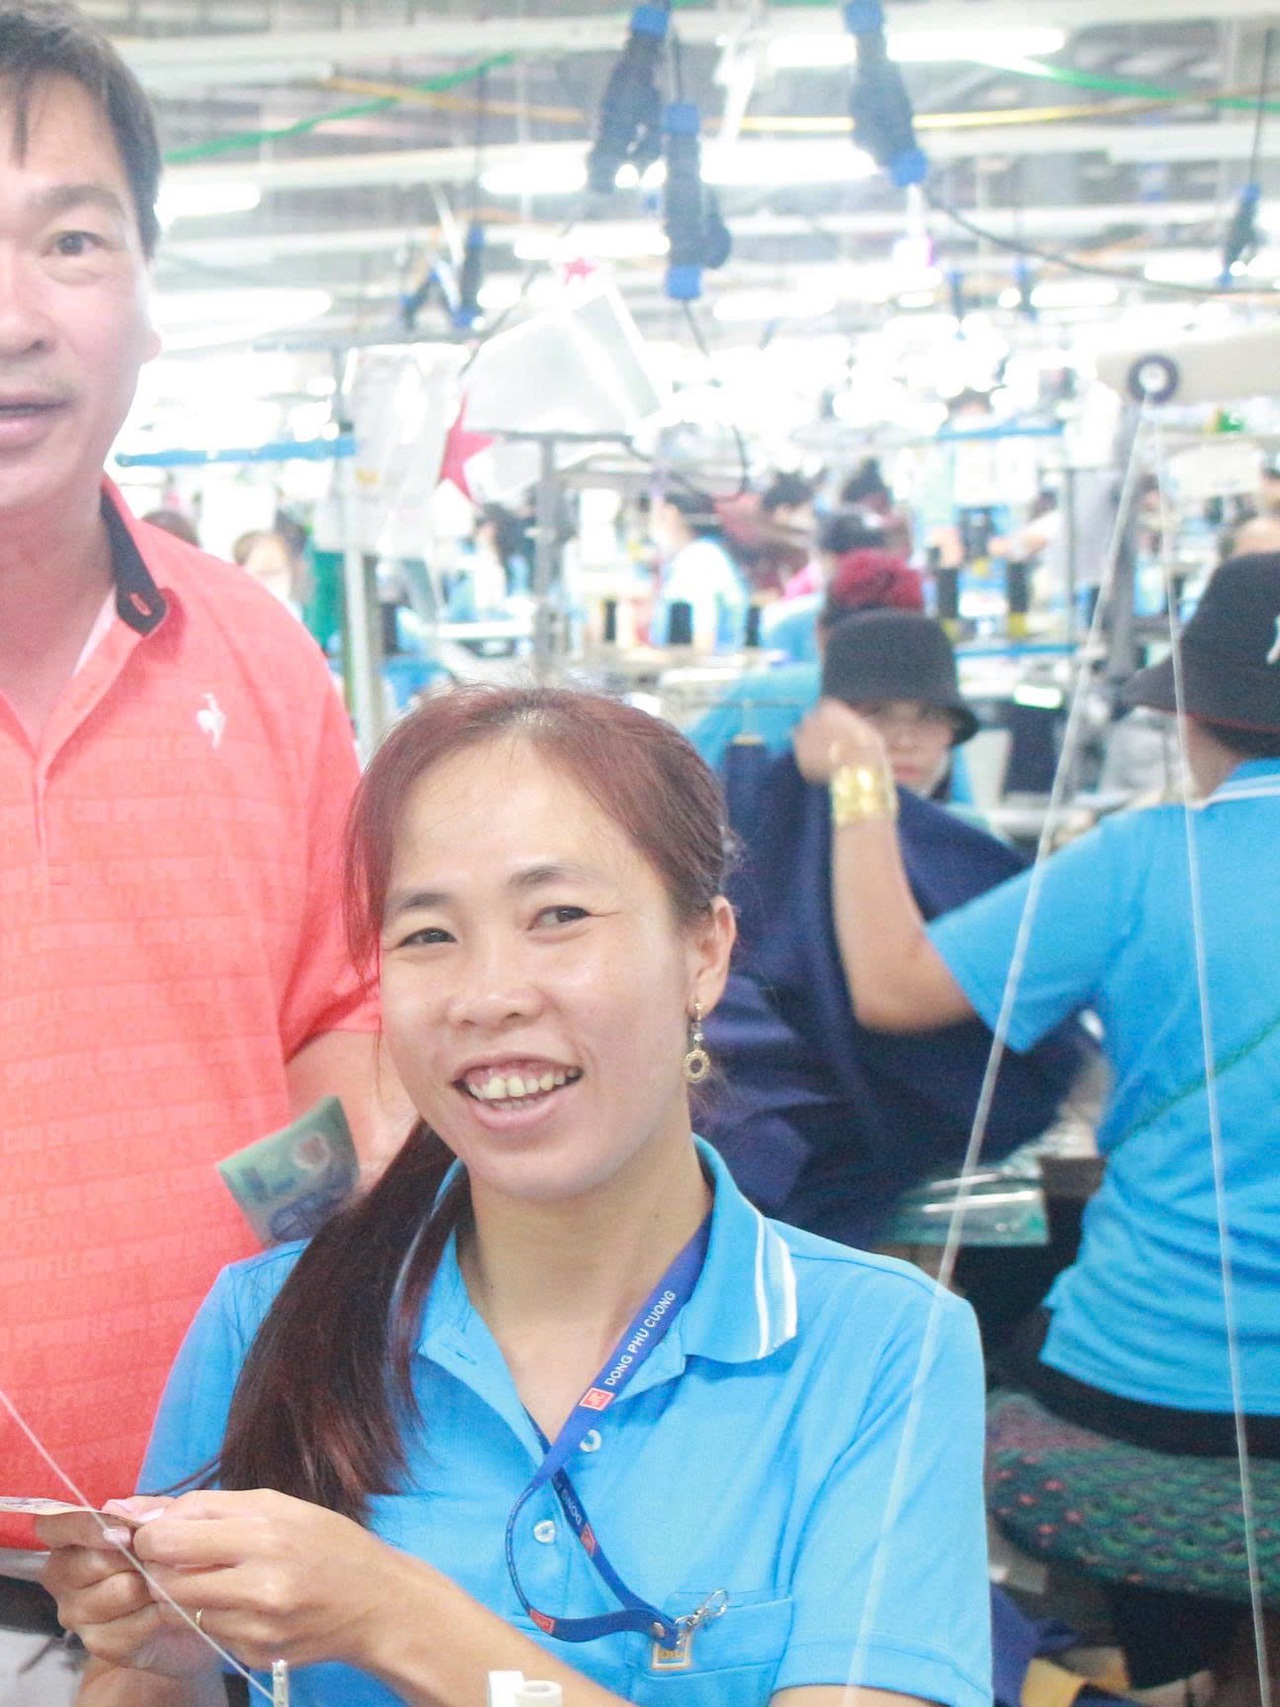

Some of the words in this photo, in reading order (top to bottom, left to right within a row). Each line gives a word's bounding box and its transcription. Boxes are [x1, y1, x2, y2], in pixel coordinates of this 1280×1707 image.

[604, 1353, 633, 1386] DONG
[627, 1328, 649, 1354] PHU
[644, 1290, 676, 1327] CUONG
